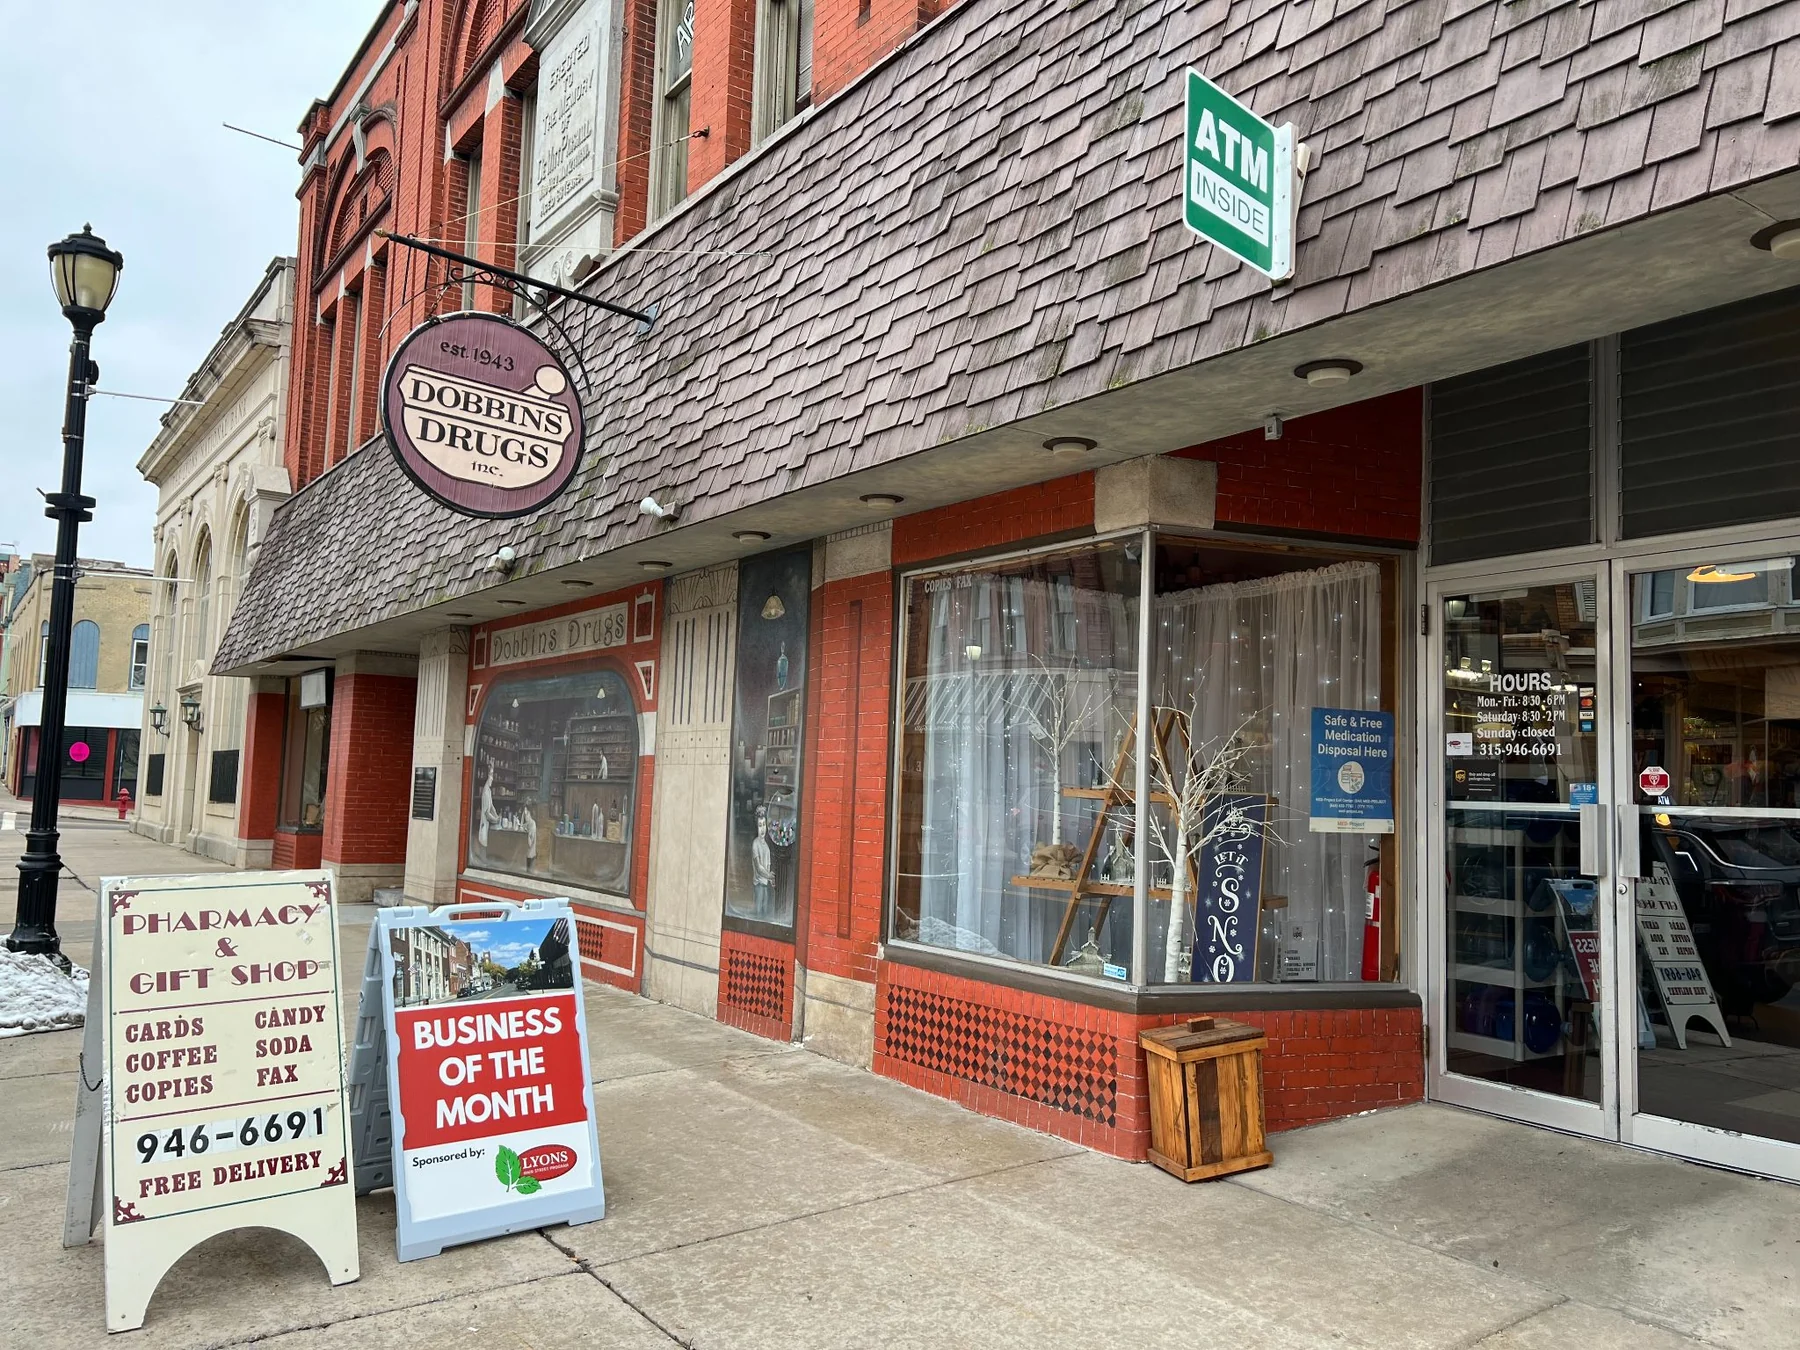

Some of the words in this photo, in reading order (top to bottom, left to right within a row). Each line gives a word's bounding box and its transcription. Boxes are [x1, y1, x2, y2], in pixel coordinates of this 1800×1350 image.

[549, 33, 590, 91] ERECTED
[563, 72, 574, 93] TO
[542, 108, 558, 136] THE
[559, 69, 594, 120] MEMORY
[561, 110, 572, 134] OF
[1194, 107, 1268, 194] ATM
[1196, 171, 1264, 235] INSIDE
[473, 348, 515, 372] 1943
[408, 378, 563, 436] DOBBINS
[416, 416, 549, 469] DRUGS
[471, 460, 503, 477] inc.
[924, 578, 952, 594] COPIES
[956, 574, 972, 589] FAX
[493, 628, 557, 662] Dobbins
[568, 613, 625, 647] Drugs
[1489, 672, 1552, 692] HOURS
[1522, 694, 1541, 706] 8:30
[1324, 714, 1347, 726] Safe
[1349, 716, 1357, 727] &
[1360, 717, 1383, 728] Free
[1522, 711, 1541, 722] 8:30
[1325, 729, 1381, 743] Medication
[1521, 726, 1555, 738] closed
[1317, 743, 1361, 757] Disposal
[1364, 746, 1387, 758] Here
[1479, 743, 1562, 756] 315-946-6691
[1213, 851, 1237, 866] LET
[122, 903, 320, 935] PHARMACY
[214, 937, 239, 958] &
[129, 967, 214, 995] GIFT
[230, 959, 319, 986] SHOP
[254, 1004, 326, 1030] CANDY
[413, 1006, 563, 1050] BUSINESS
[125, 1017, 204, 1043] CARDS
[255, 1034, 313, 1058] SODA
[125, 1045, 218, 1073] COFFEE
[438, 1054, 482, 1086] OF
[488, 1047, 545, 1080] THE
[257, 1064, 299, 1087] FAX
[126, 1074, 214, 1104] COPIES
[436, 1084, 554, 1129] MONTH
[136, 1107, 323, 1164] 946-6691
[412, 1148, 468, 1168] Sponsored
[469, 1148, 485, 1159] by:
[522, 1150, 569, 1170] LYONS
[139, 1170, 202, 1198] FREE
[213, 1150, 322, 1186] DELIVERY
